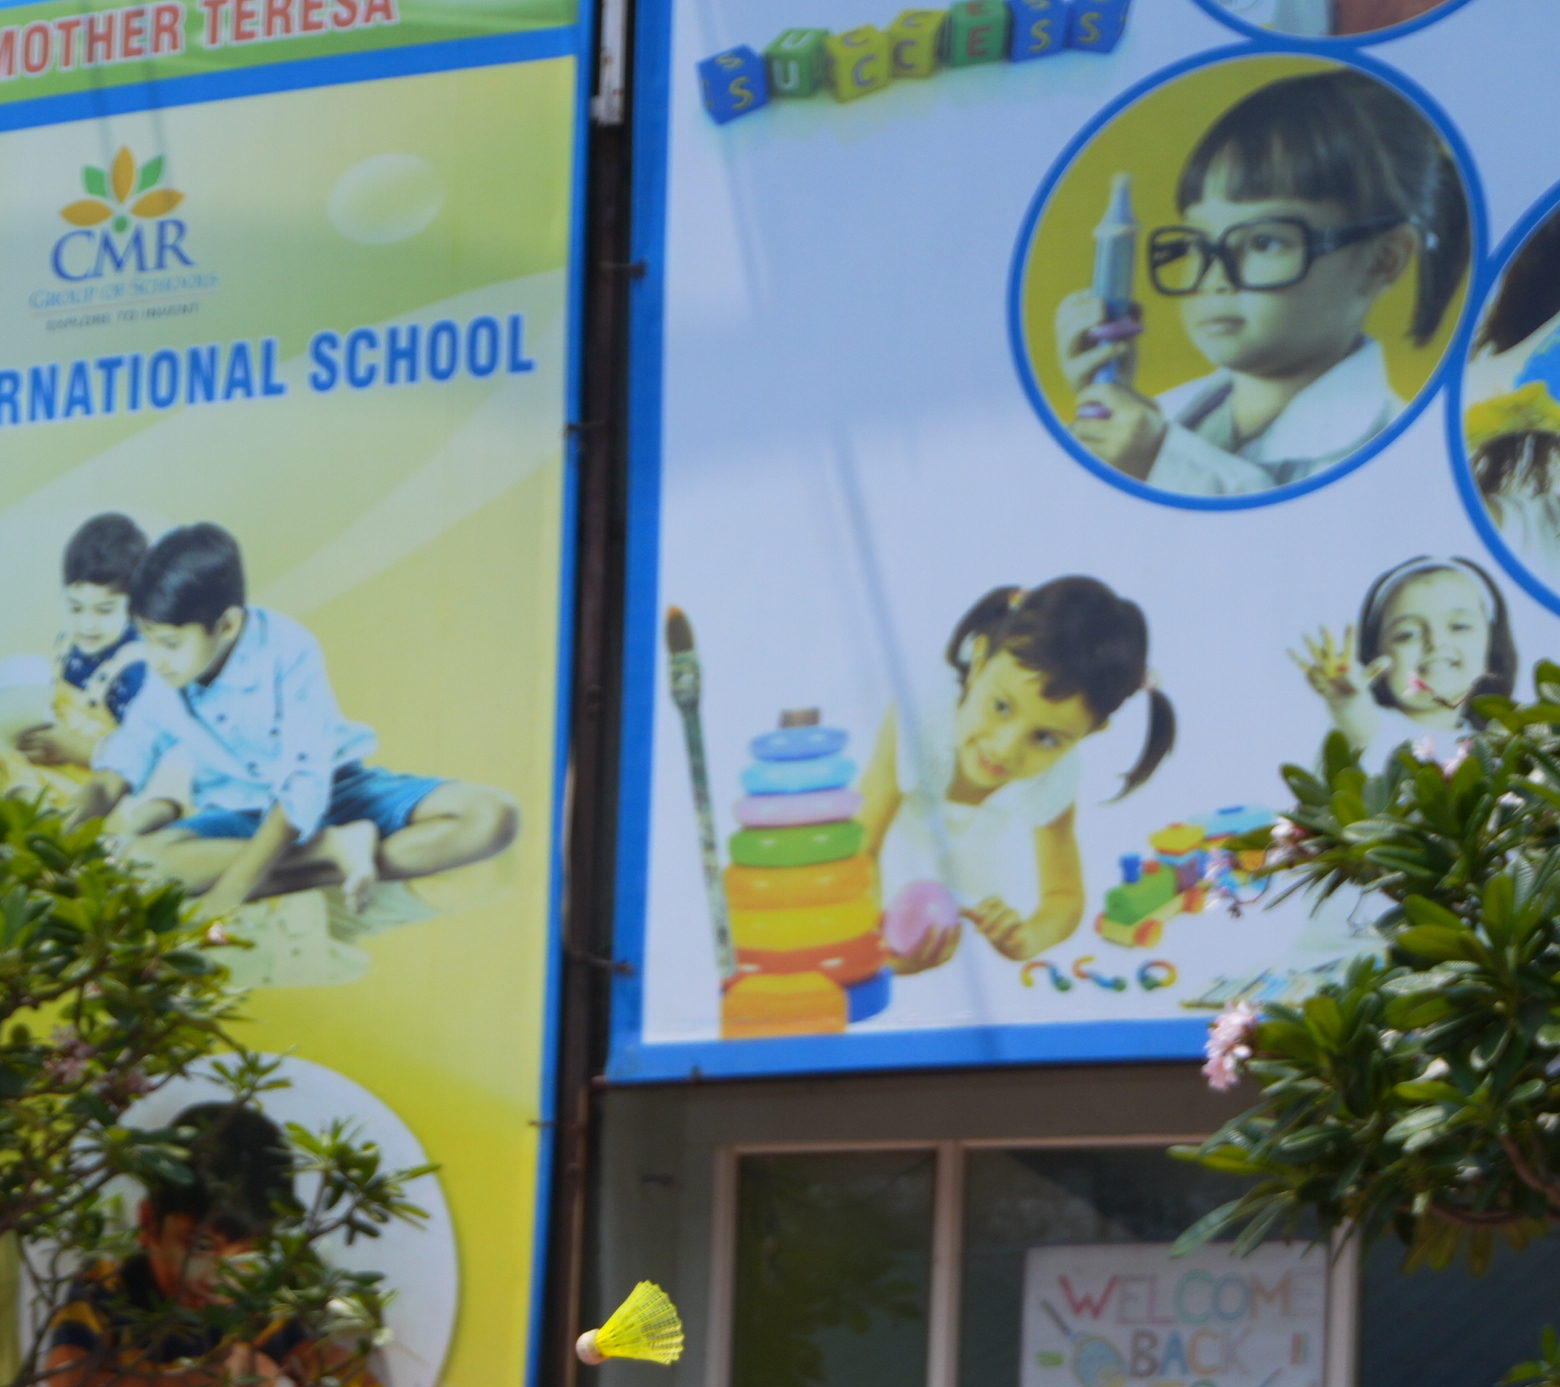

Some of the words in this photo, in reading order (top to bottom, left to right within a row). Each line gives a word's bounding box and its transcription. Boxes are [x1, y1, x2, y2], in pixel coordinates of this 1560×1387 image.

[50, 218, 197, 282] CMR
[308, 313, 536, 393] SCHOOL
[1059, 1266, 1321, 1325] WELCOME
[1129, 1328, 1251, 1378] BACK
